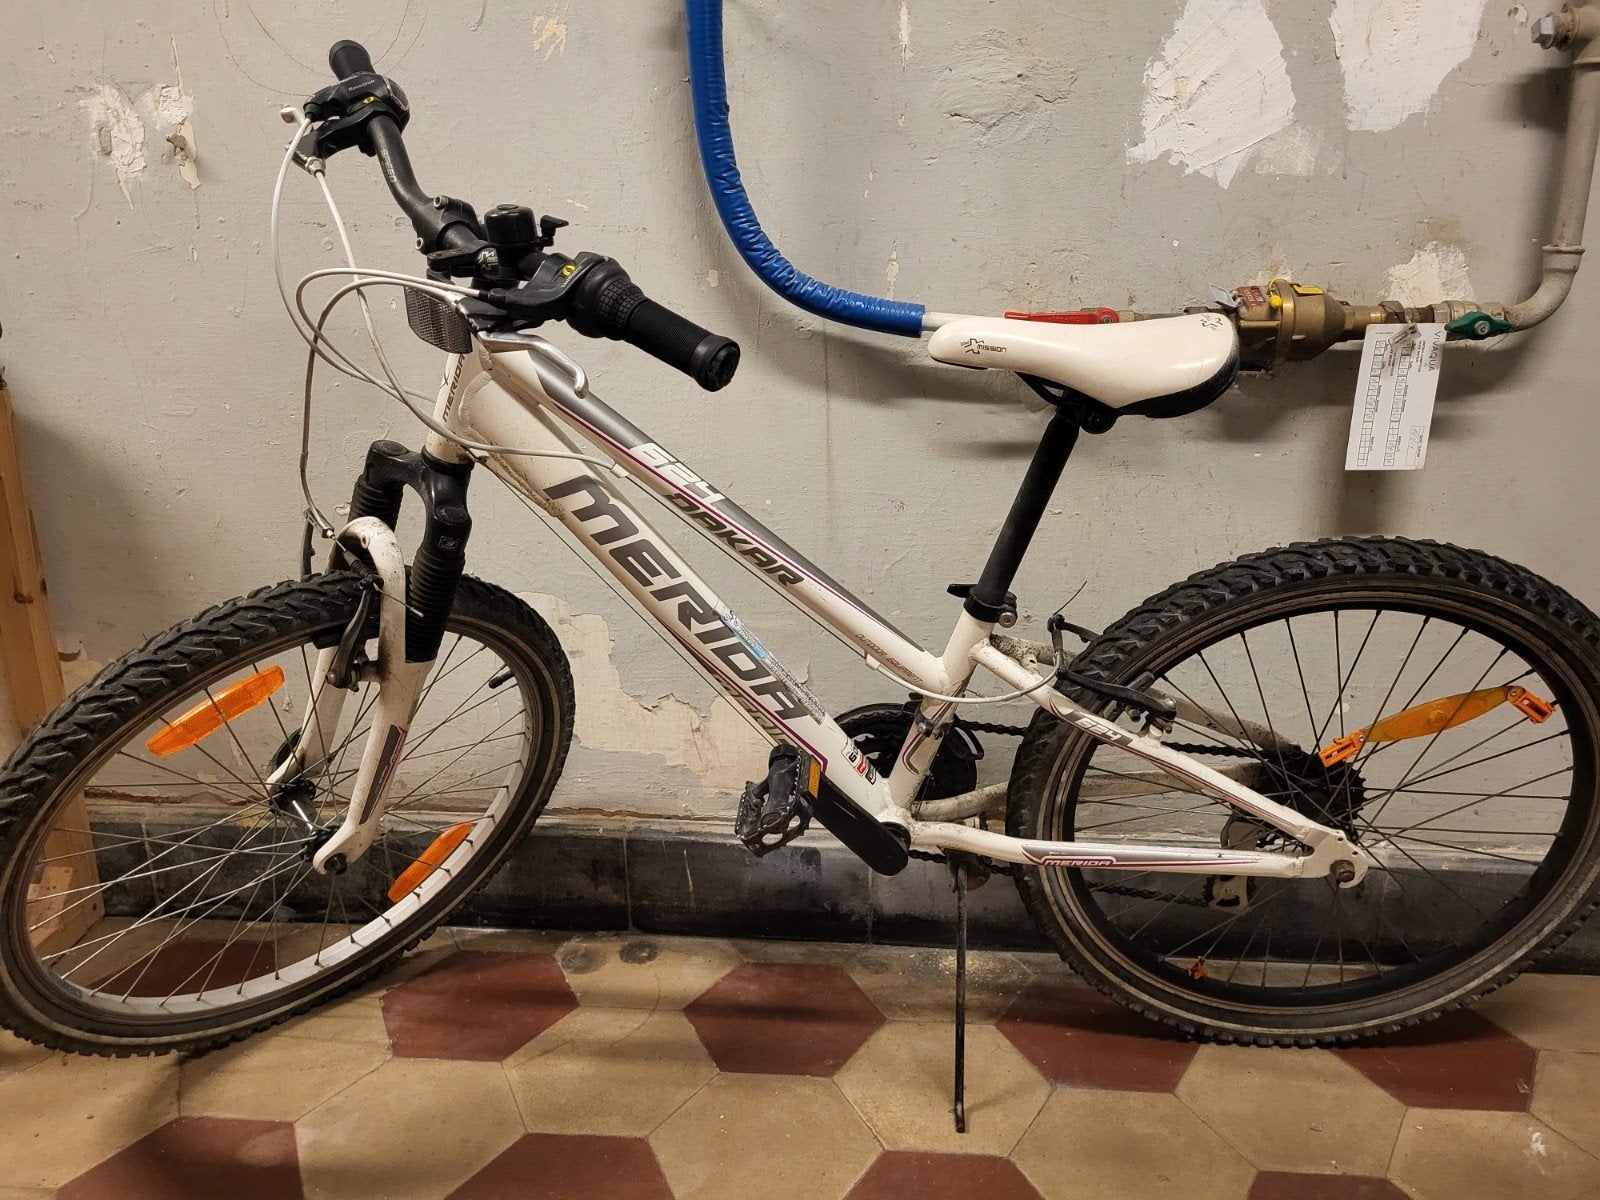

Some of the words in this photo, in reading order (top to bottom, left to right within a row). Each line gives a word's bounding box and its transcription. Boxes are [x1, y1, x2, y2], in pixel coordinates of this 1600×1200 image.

[1427, 330, 1442, 372] VIVAQUA
[629, 442, 726, 504] 624
[662, 492, 805, 587] DAKAR
[543, 474, 809, 720] MERIDA
[1074, 717, 1122, 741] 624
[1044, 859, 1112, 867] MERIDA
